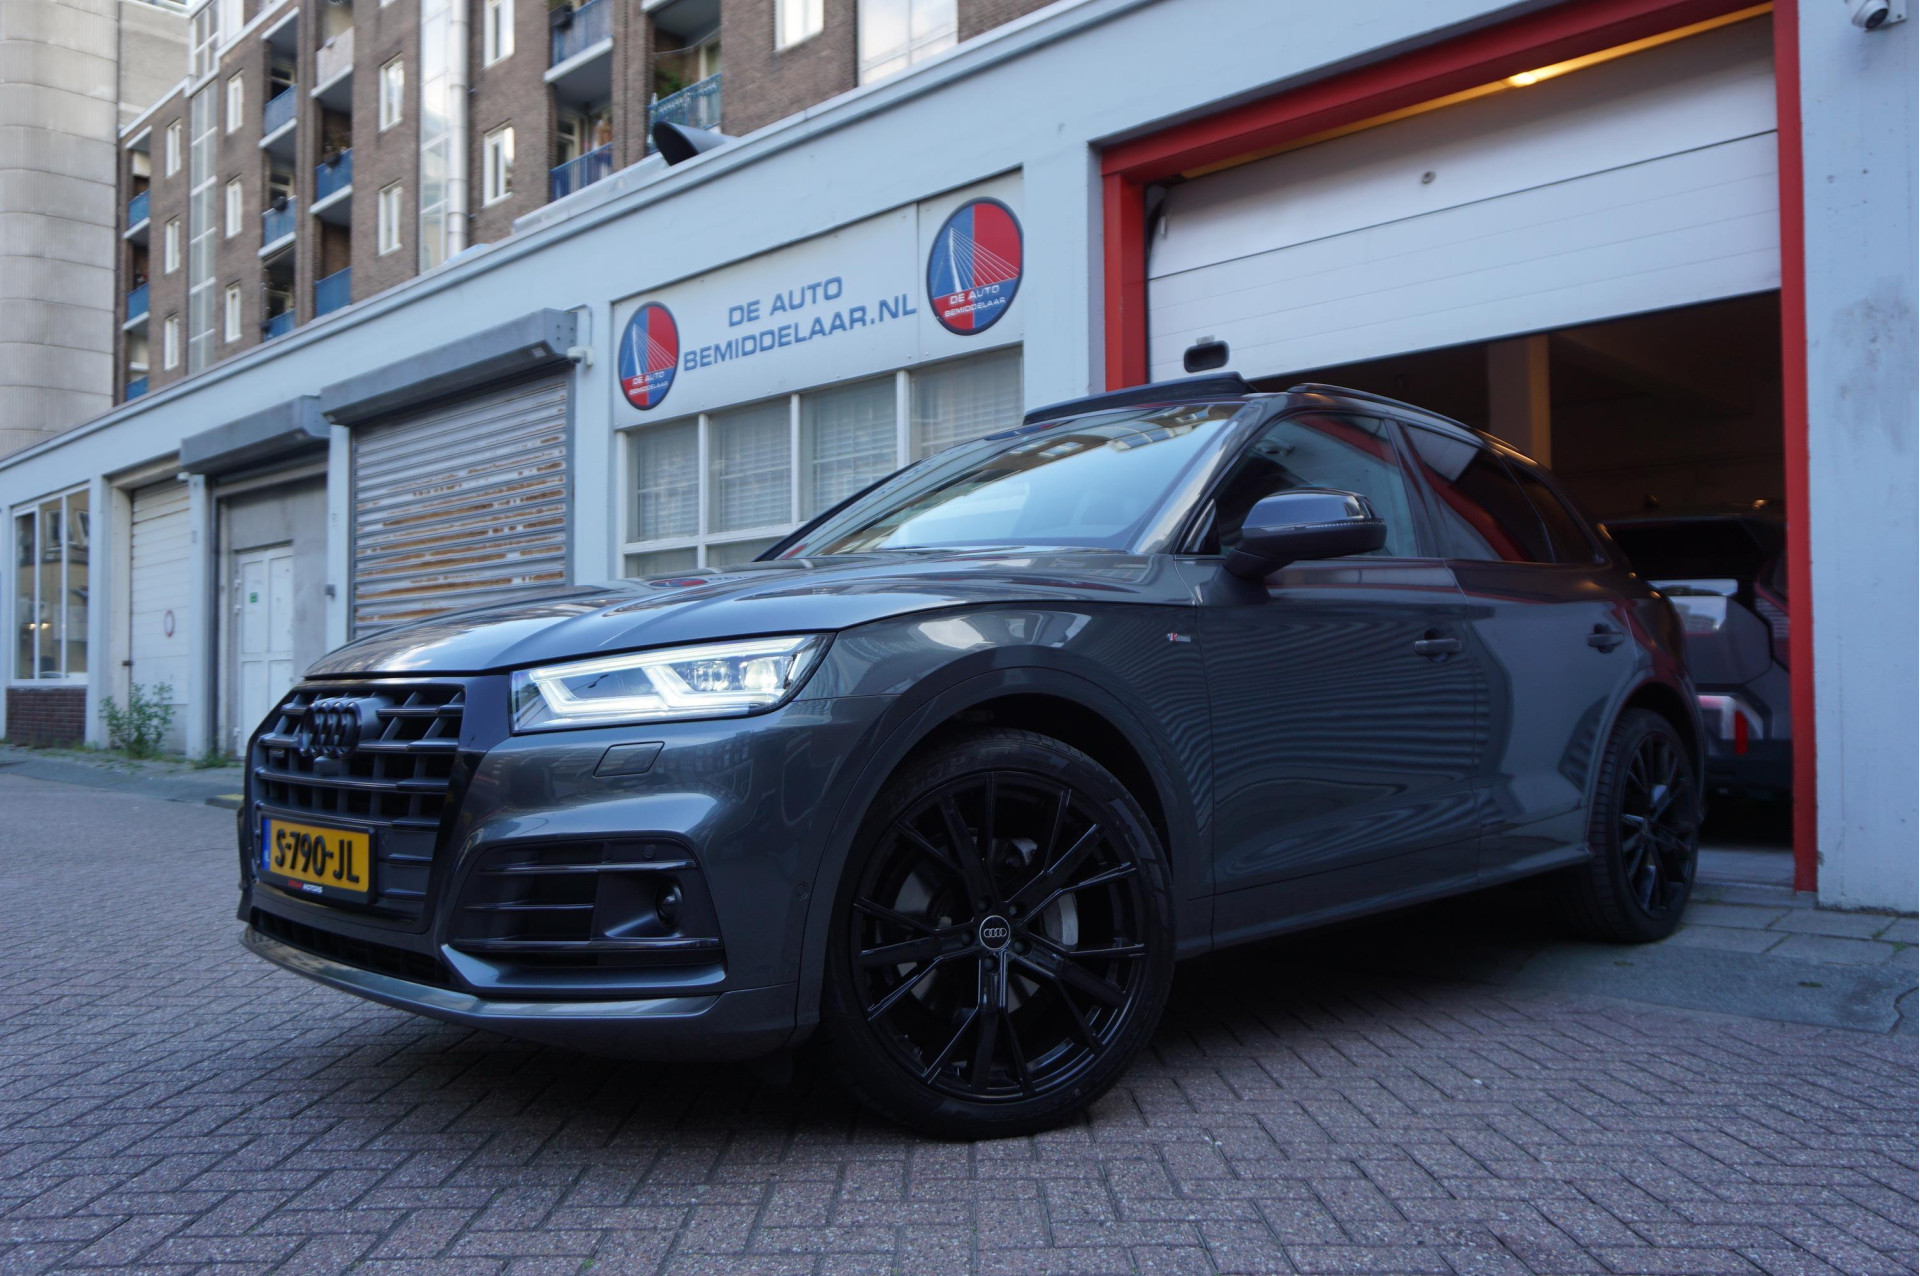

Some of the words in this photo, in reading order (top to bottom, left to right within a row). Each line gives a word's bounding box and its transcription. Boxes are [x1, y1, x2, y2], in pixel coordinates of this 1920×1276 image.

[728, 300, 761, 327] DE
[769, 276, 843, 316] AUTO
[949, 293, 966, 305] DE
[967, 284, 1000, 300] AUTO
[944, 297, 1007, 318] BEMIDDELAAR
[683, 293, 918, 372] BEMIDDELAAR.NL
[628, 380, 670, 395] BEMIDDELAAR
[632, 375, 644, 385] DE
[644, 370, 665, 382] AUTO
[274, 828, 360, 884] S-790-JL
